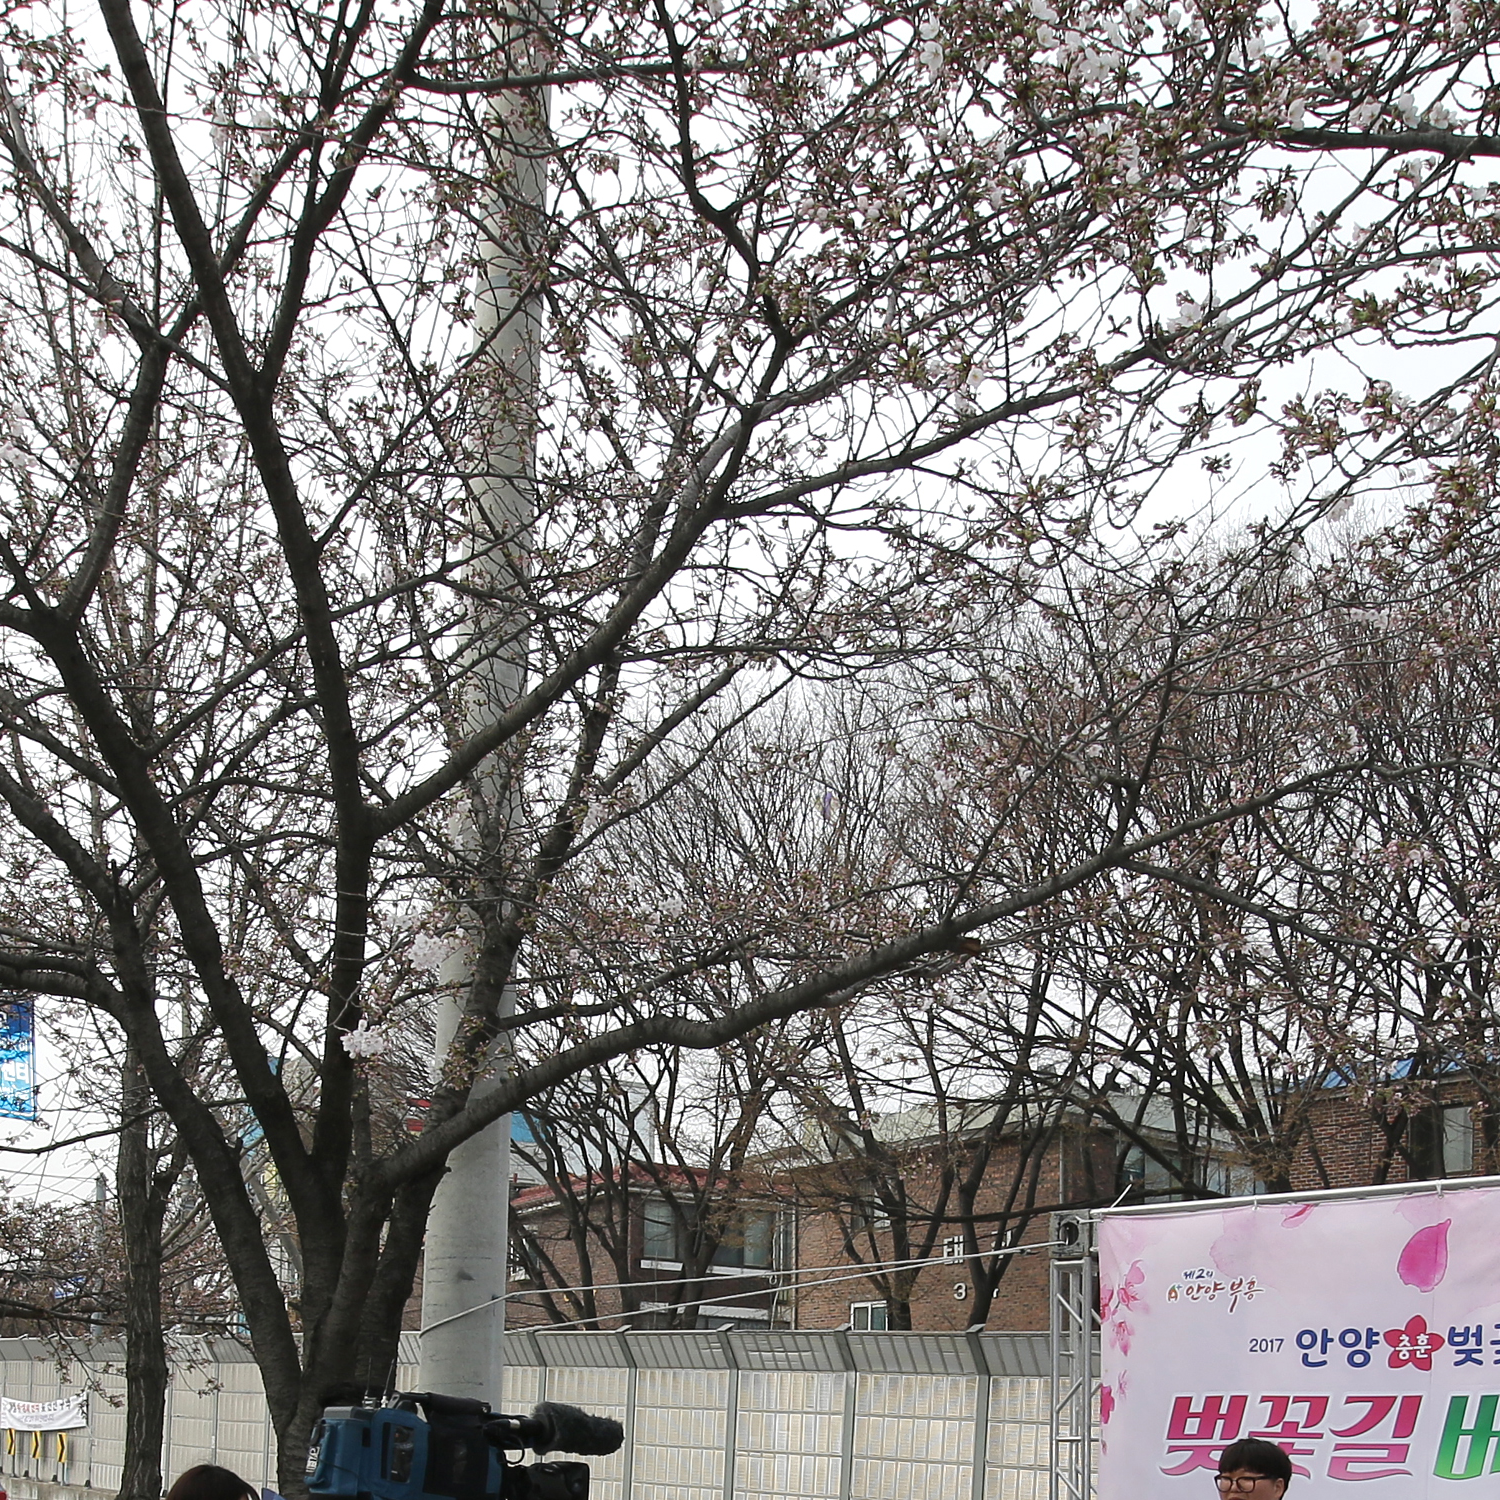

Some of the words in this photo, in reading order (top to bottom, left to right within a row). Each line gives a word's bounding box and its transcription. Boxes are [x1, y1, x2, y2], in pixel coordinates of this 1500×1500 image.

[1229, 1277, 1264, 1313] 부흥
[1248, 1337, 1285, 1353] 2017
[1295, 1326, 1380, 1369] 안양
[1394, 1332, 1430, 1361] 충훈
